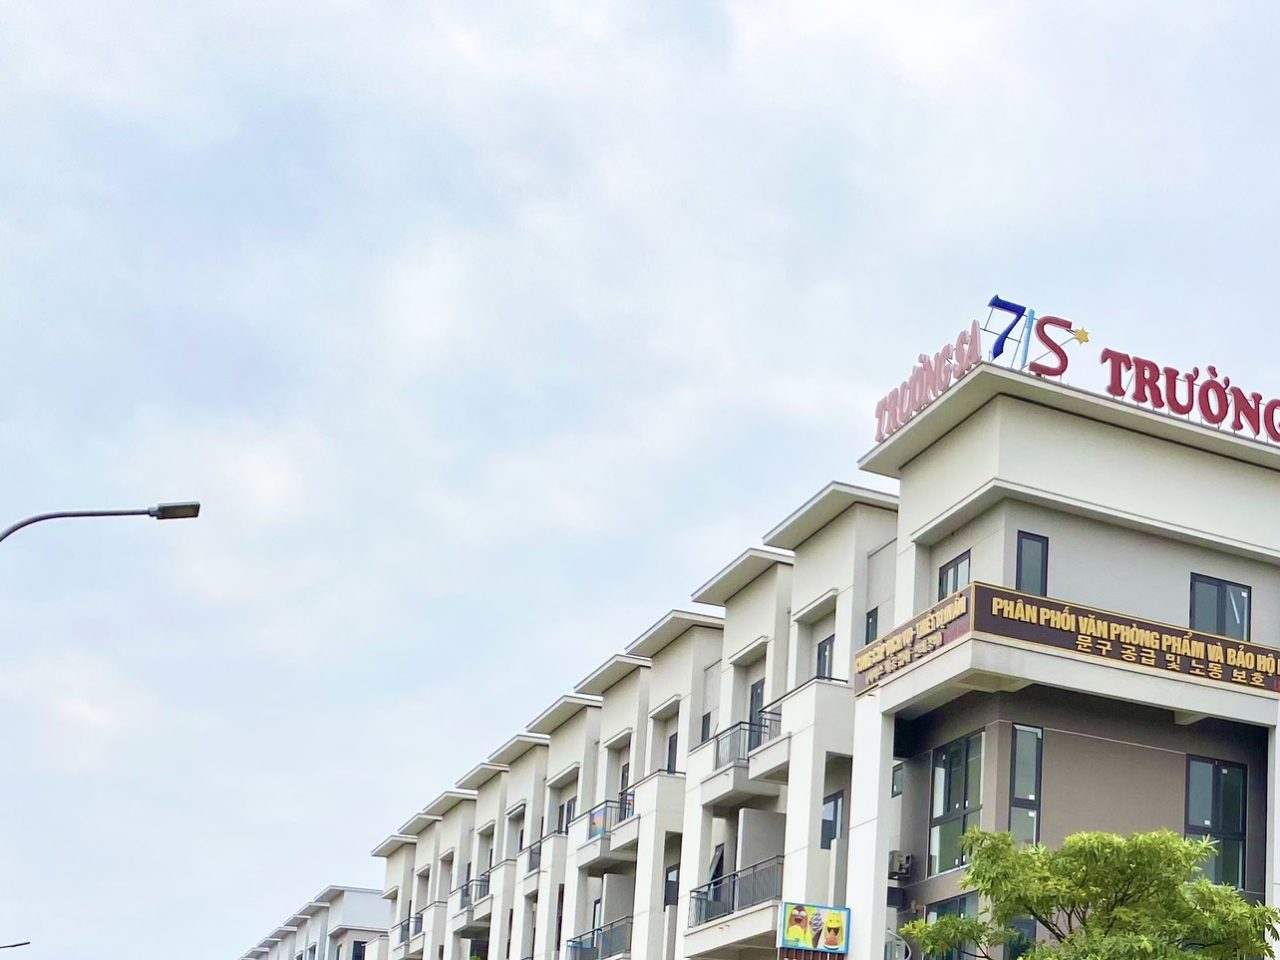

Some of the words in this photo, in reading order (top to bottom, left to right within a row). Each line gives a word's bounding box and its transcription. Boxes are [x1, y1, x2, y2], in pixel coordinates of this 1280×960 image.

[954, 320, 982, 380] SA
[992, 597, 1037, 624] PHÂN
[1040, 606, 1076, 632] PHỐI
[1078, 614, 1108, 638] VĂN
[1110, 623, 1159, 650] PHÒNG
[1162, 632, 1205, 659] PHẨM
[1207, 642, 1224, 664] VÀ
[1227, 645, 1254, 669] BẢO
[1257, 653, 1275, 677] HỘ
[1075, 634, 1112, 656] 문구
[1120, 644, 1157, 666] 공급
[1190, 659, 1223, 679] 노동
[1232, 668, 1265, 687] 보호
